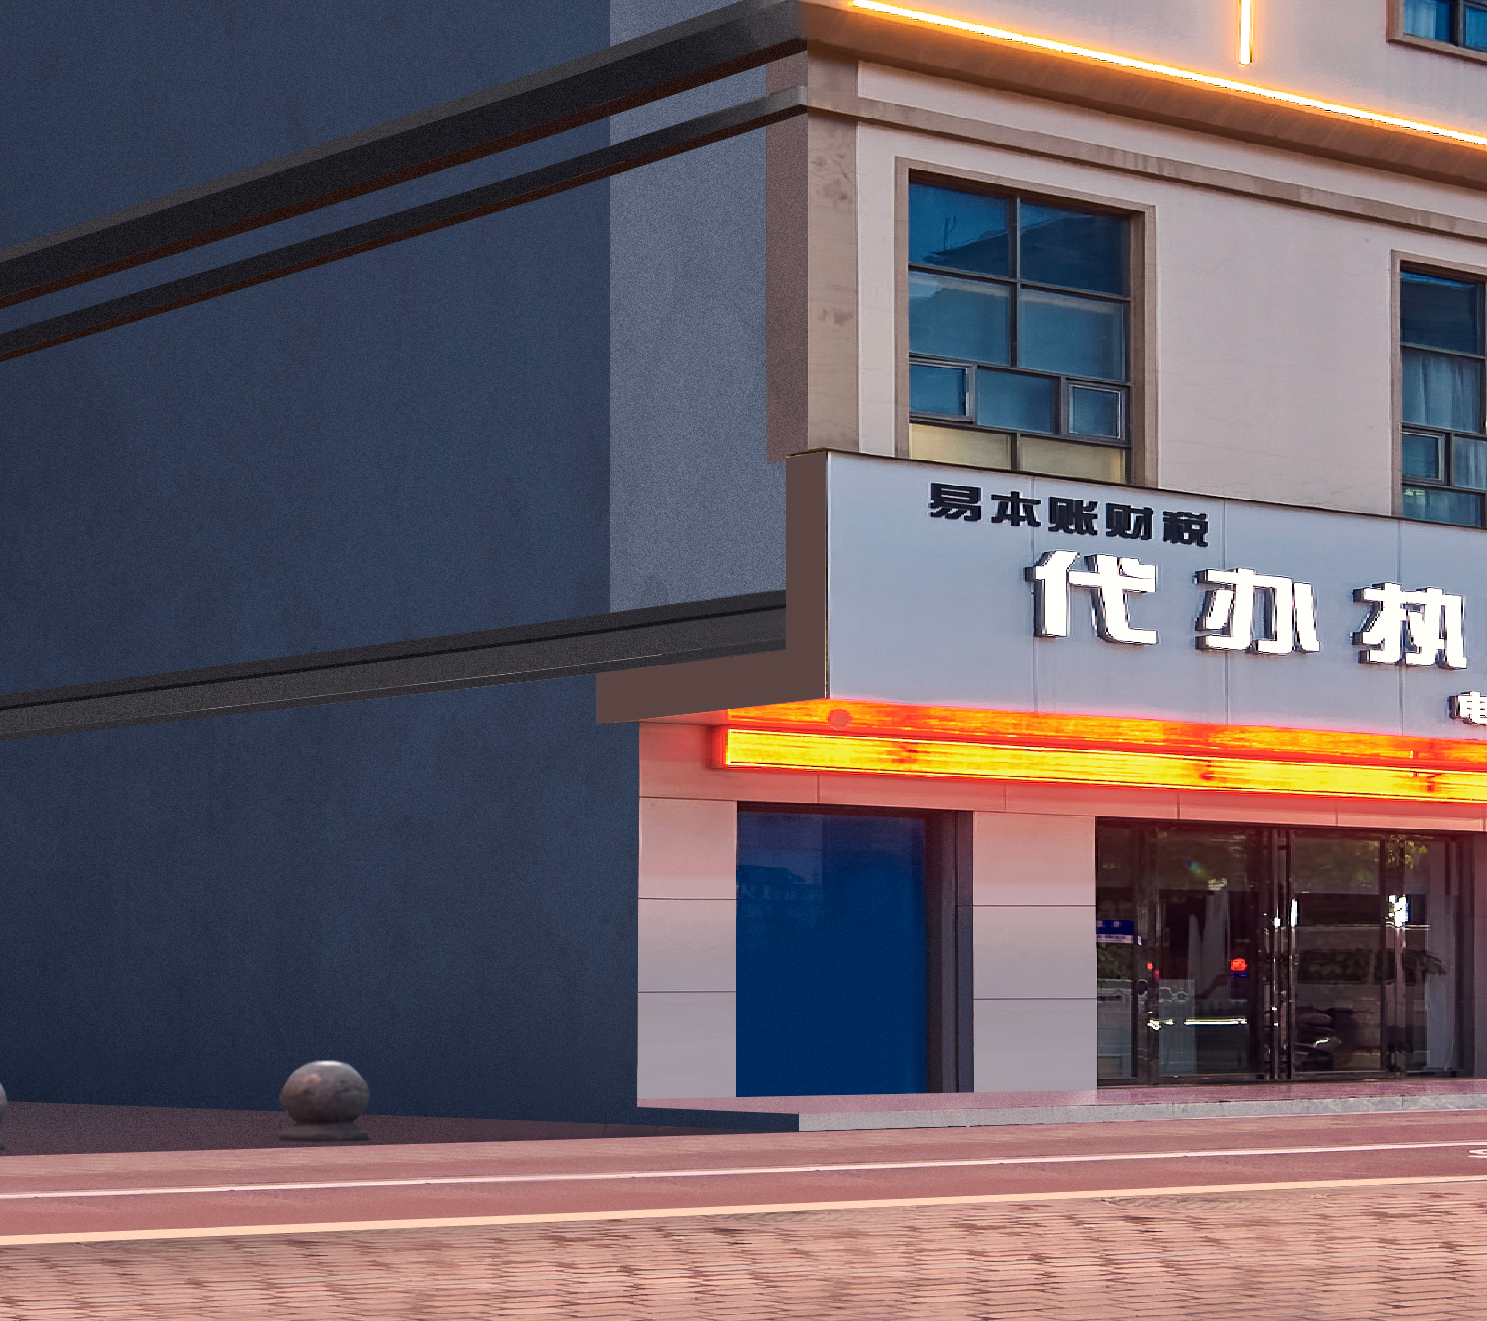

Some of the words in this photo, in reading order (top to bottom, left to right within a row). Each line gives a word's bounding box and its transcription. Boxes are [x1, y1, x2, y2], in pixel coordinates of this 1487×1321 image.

[928, 483, 1209, 547] 易本账财税
